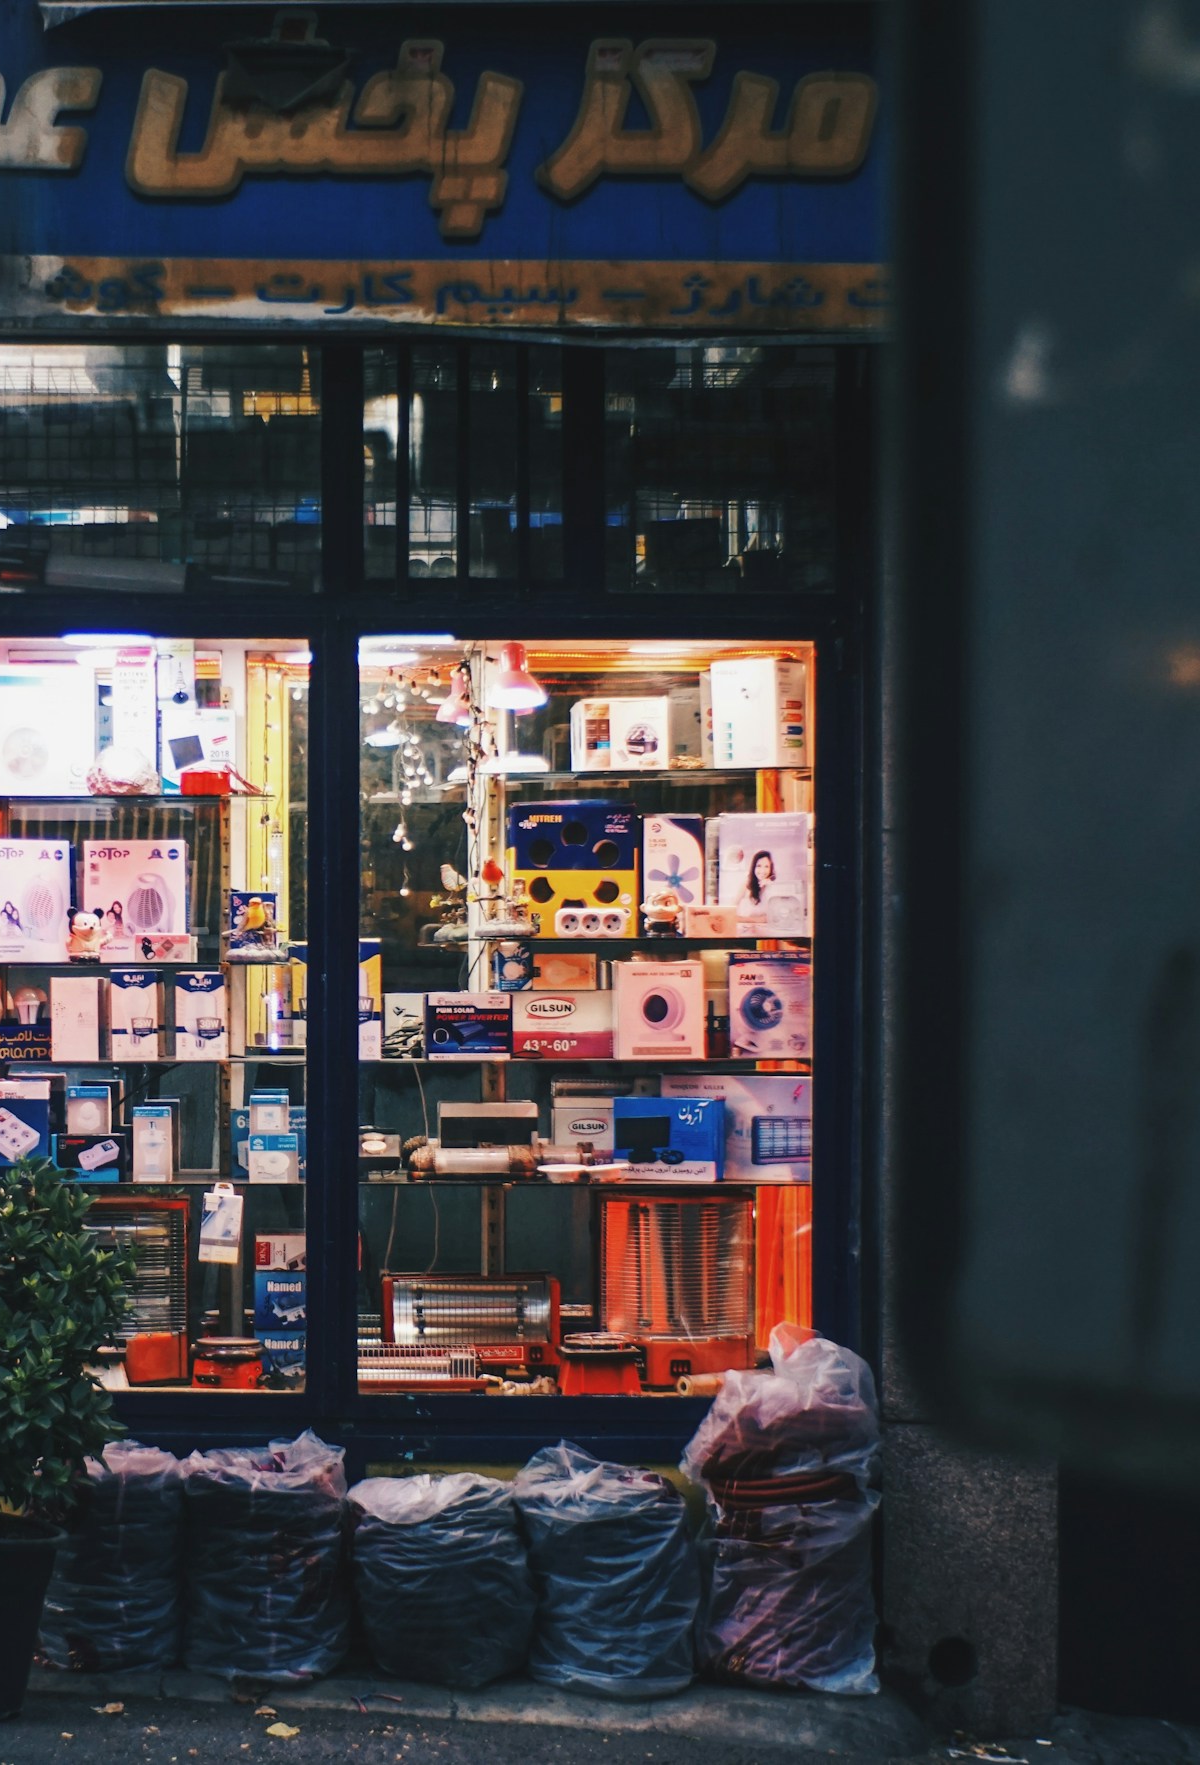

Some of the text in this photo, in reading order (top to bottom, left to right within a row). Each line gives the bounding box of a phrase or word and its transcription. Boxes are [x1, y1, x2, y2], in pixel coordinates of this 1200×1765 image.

[537, 38, 878, 202] مرکز
[256, 271, 412, 314] کارت
[668, 272, 824, 316] شارژ
[210, 750, 230, 758] 2018
[528, 814, 563, 824] MITREH
[89, 847, 130, 860] POTOP
[530, 1004, 573, 1014] GILSUN
[236, 1115, 247, 1129] 6
[571, 1123, 604, 1131] GILSUN
[267, 1281, 302, 1292] Hamed
[264, 1338, 299, 1350] Hamed
